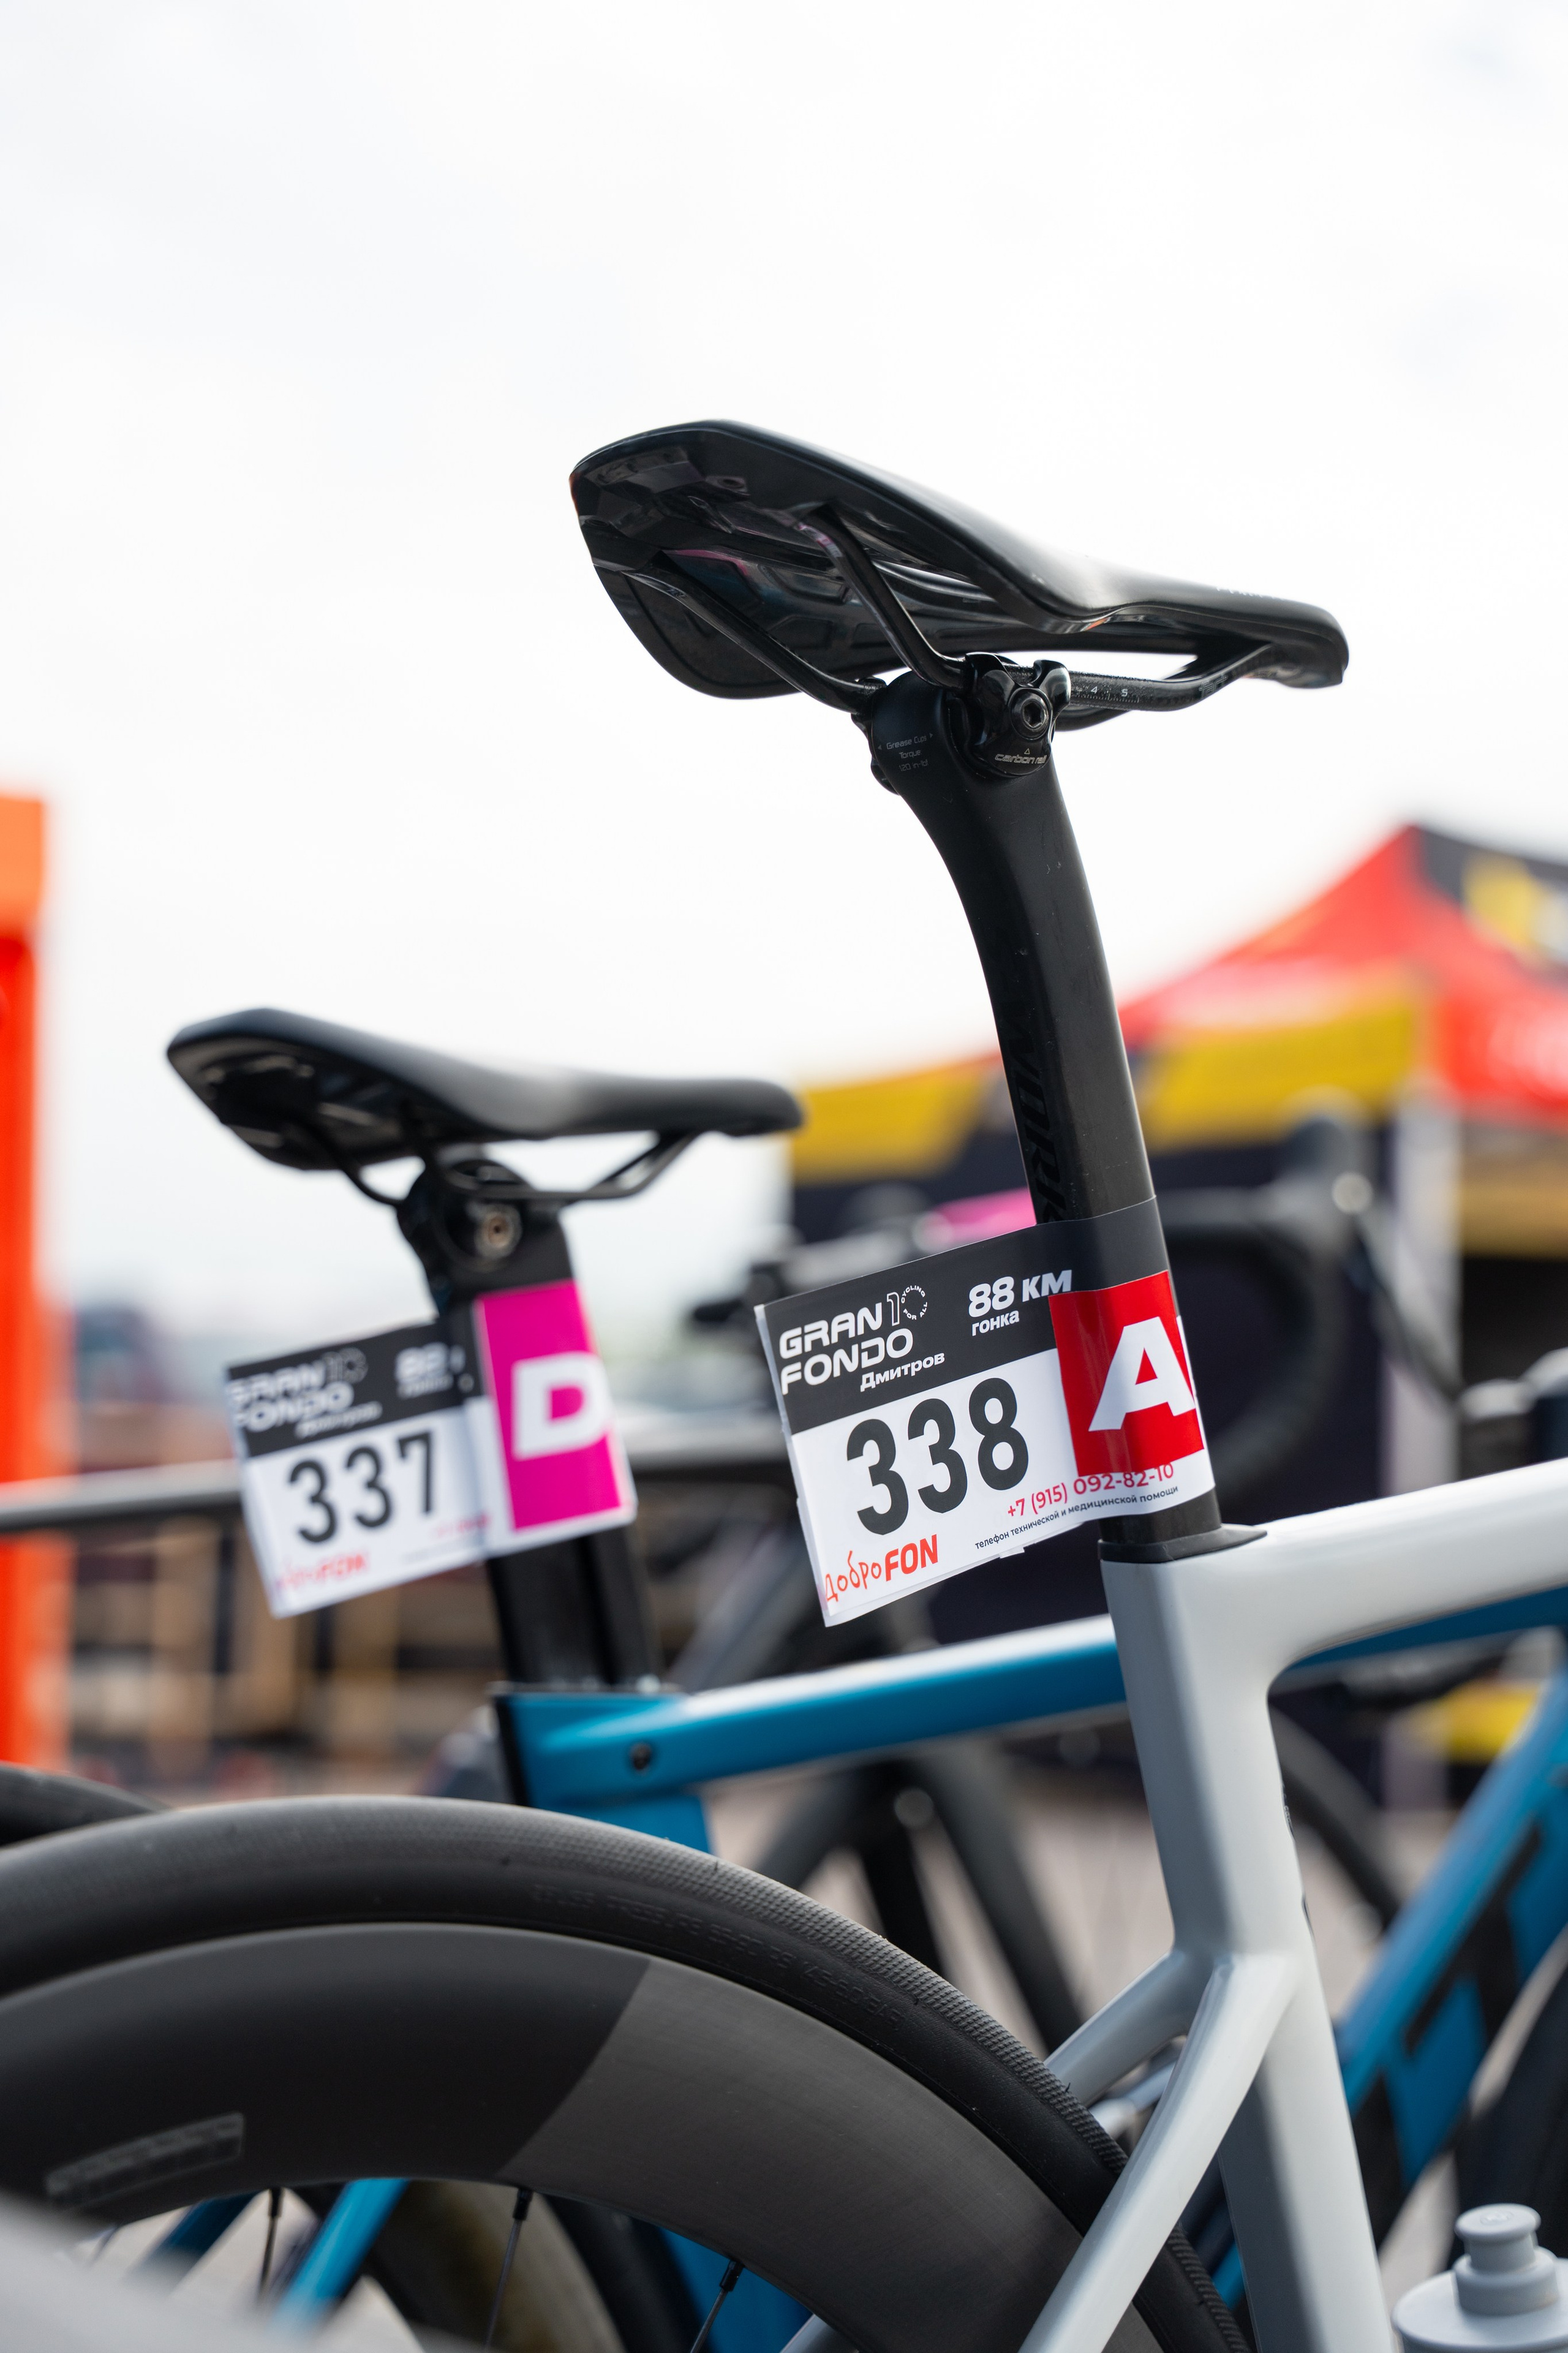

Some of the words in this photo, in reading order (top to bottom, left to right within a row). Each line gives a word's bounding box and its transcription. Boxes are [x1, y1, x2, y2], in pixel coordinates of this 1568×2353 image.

[886, 738, 913, 750] Grease
[914, 735, 928, 746] Cups
[994, 753, 1035, 766] carbon
[901, 1285, 925, 1304] CYCLING
[903, 1309, 917, 1320] FOR
[919, 1302, 928, 1318] ALL
[968, 1276, 1015, 1318] 88
[779, 1302, 883, 1359] GRAN
[971, 1310, 1020, 1337] гонка
[780, 1328, 914, 1396] FONDO
[860, 1352, 946, 1392] Дмитров
[511, 1352, 614, 1460] D
[846, 1377, 1029, 1536] 338
[288, 1432, 433, 1544] 337
[1008, 1498, 1025, 1517] +7
[1031, 1482, 1068, 1516] (915)
[1073, 1463, 1174, 1495] 092-82-10
[974, 1530, 1010, 1550] телефон
[1010, 1509, 1060, 1536] технической
[1061, 1508, 1067, 1517] и
[1068, 1494, 1137, 1513] медицинской
[1139, 1485, 1179, 1503] помощи
